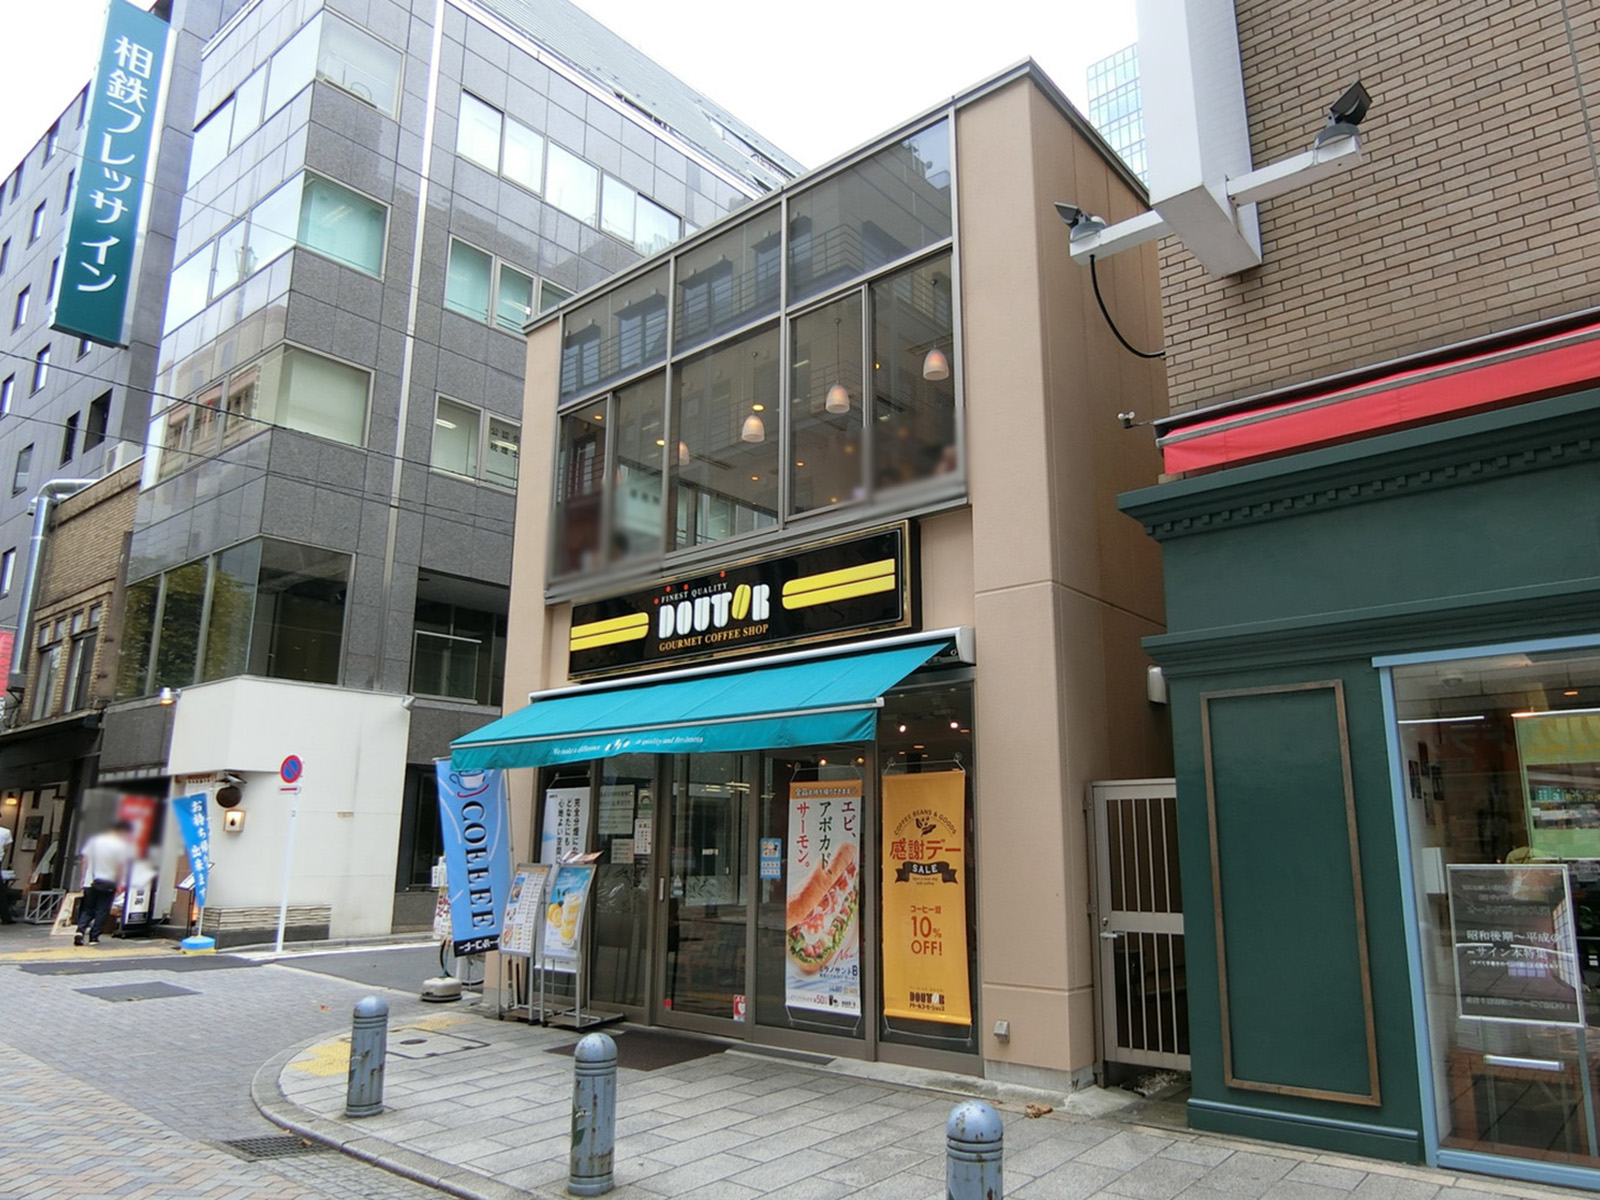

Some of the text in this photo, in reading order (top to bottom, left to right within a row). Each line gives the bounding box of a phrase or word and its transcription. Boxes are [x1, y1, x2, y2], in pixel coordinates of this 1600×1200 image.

[76, 35, 155, 293] 相鉄フレッサイン
[661, 582, 728, 604] FINEST QUALITY
[658, 583, 771, 640] DOUTOR
[659, 623, 770, 653] GOURMET COFFEE SHOP
[841, 801, 857, 839] エビ、
[894, 813, 912, 836] COFFEE
[912, 809, 932, 817] BEANS
[939, 814, 957, 836] GOODS
[796, 801, 811, 868] サーモン。
[818, 801, 833, 875] アボカド、
[890, 837, 962, 861] 感謝デー
[912, 864, 938, 875] SALE
[911, 915, 942, 938] 10%
[911, 940, 942, 956] OFF!
[909, 990, 945, 1005] DOUTOR
